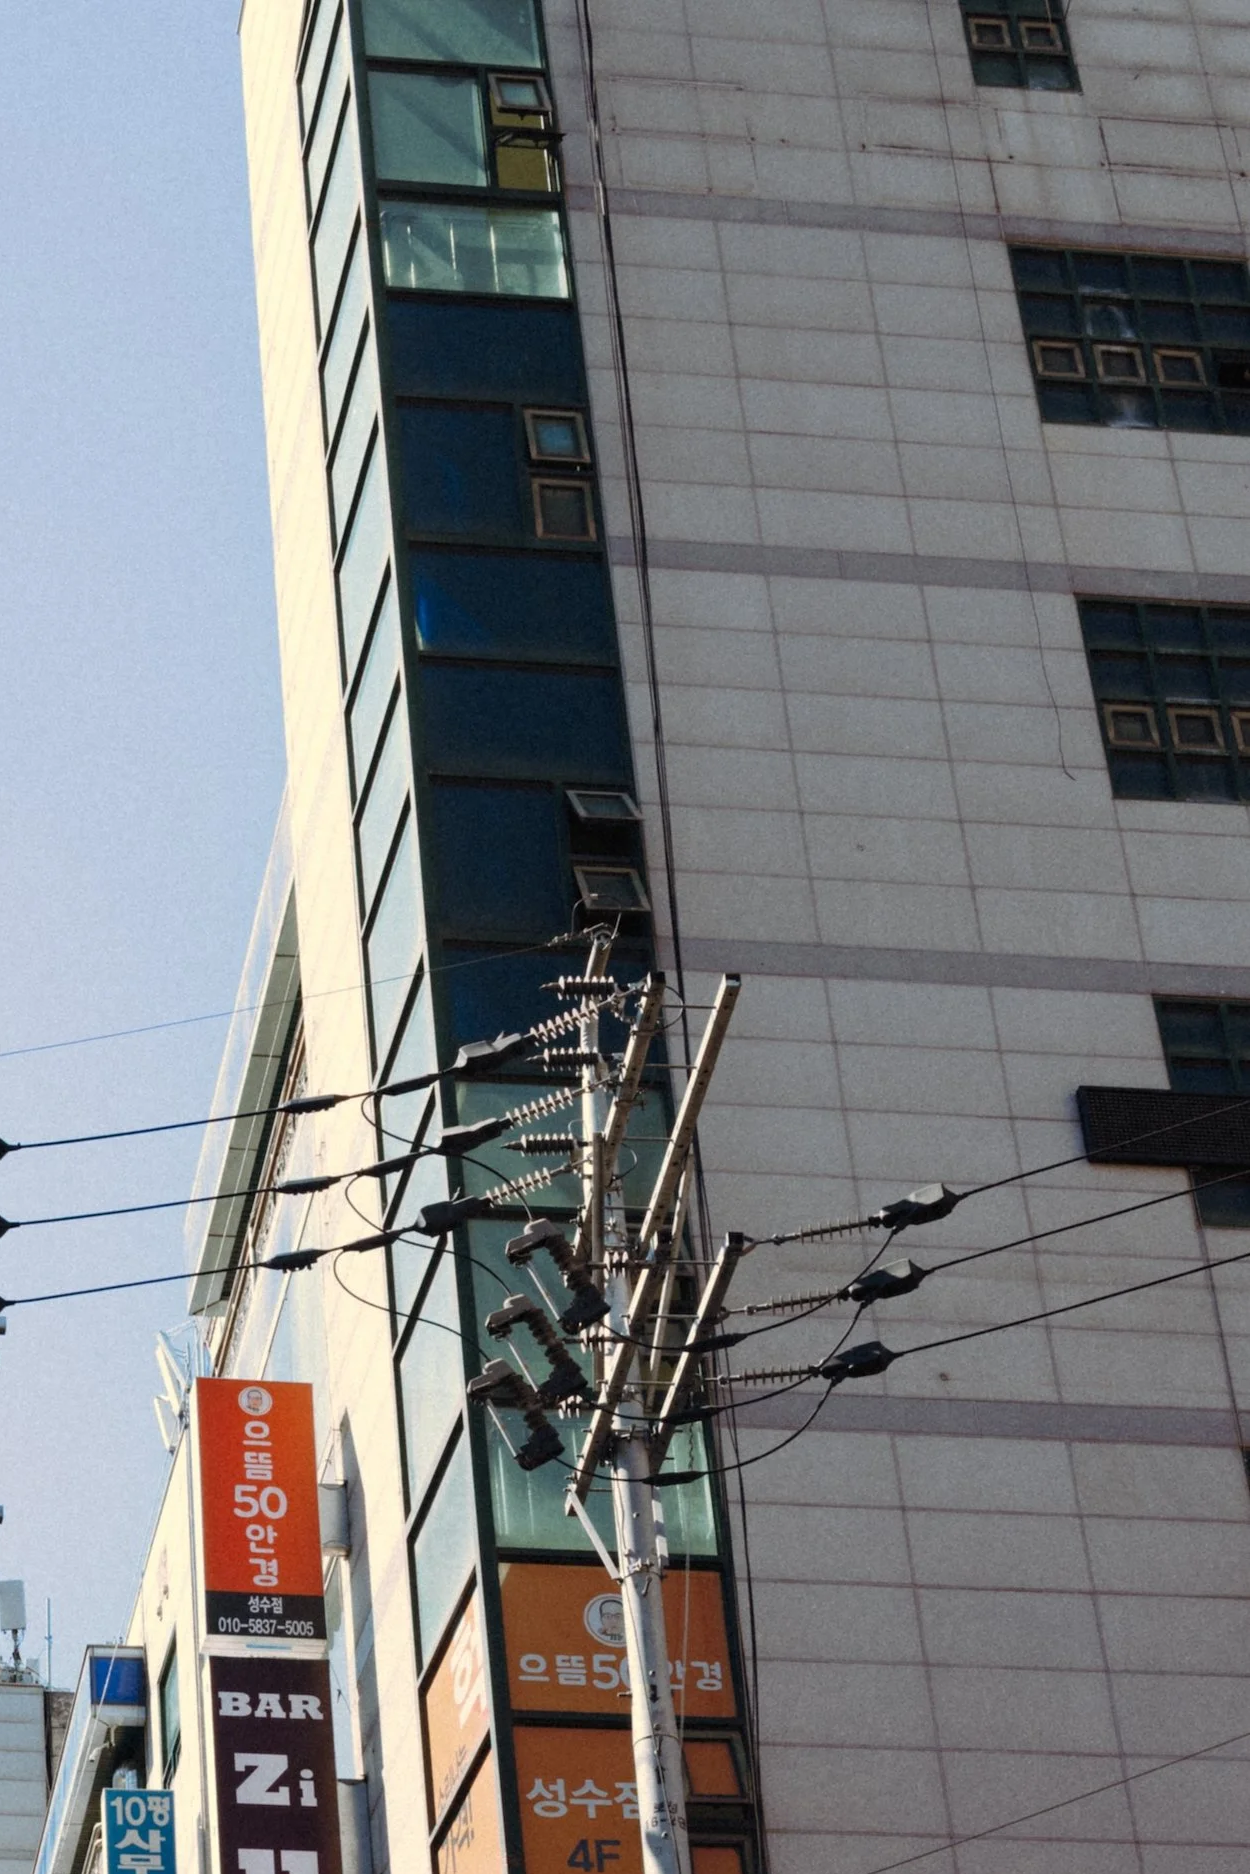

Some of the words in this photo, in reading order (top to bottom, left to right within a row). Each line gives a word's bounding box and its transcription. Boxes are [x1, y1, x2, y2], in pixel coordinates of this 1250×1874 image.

[233, 1419, 288, 1588] 으뜸50안경
[247, 1596, 284, 1614] 성수점
[217, 1616, 315, 1636] 010-5837-5005
[218, 1690, 324, 1721] BAR
[110, 1795, 171, 1827] 10평
[566, 1838, 621, 1874] 4F
